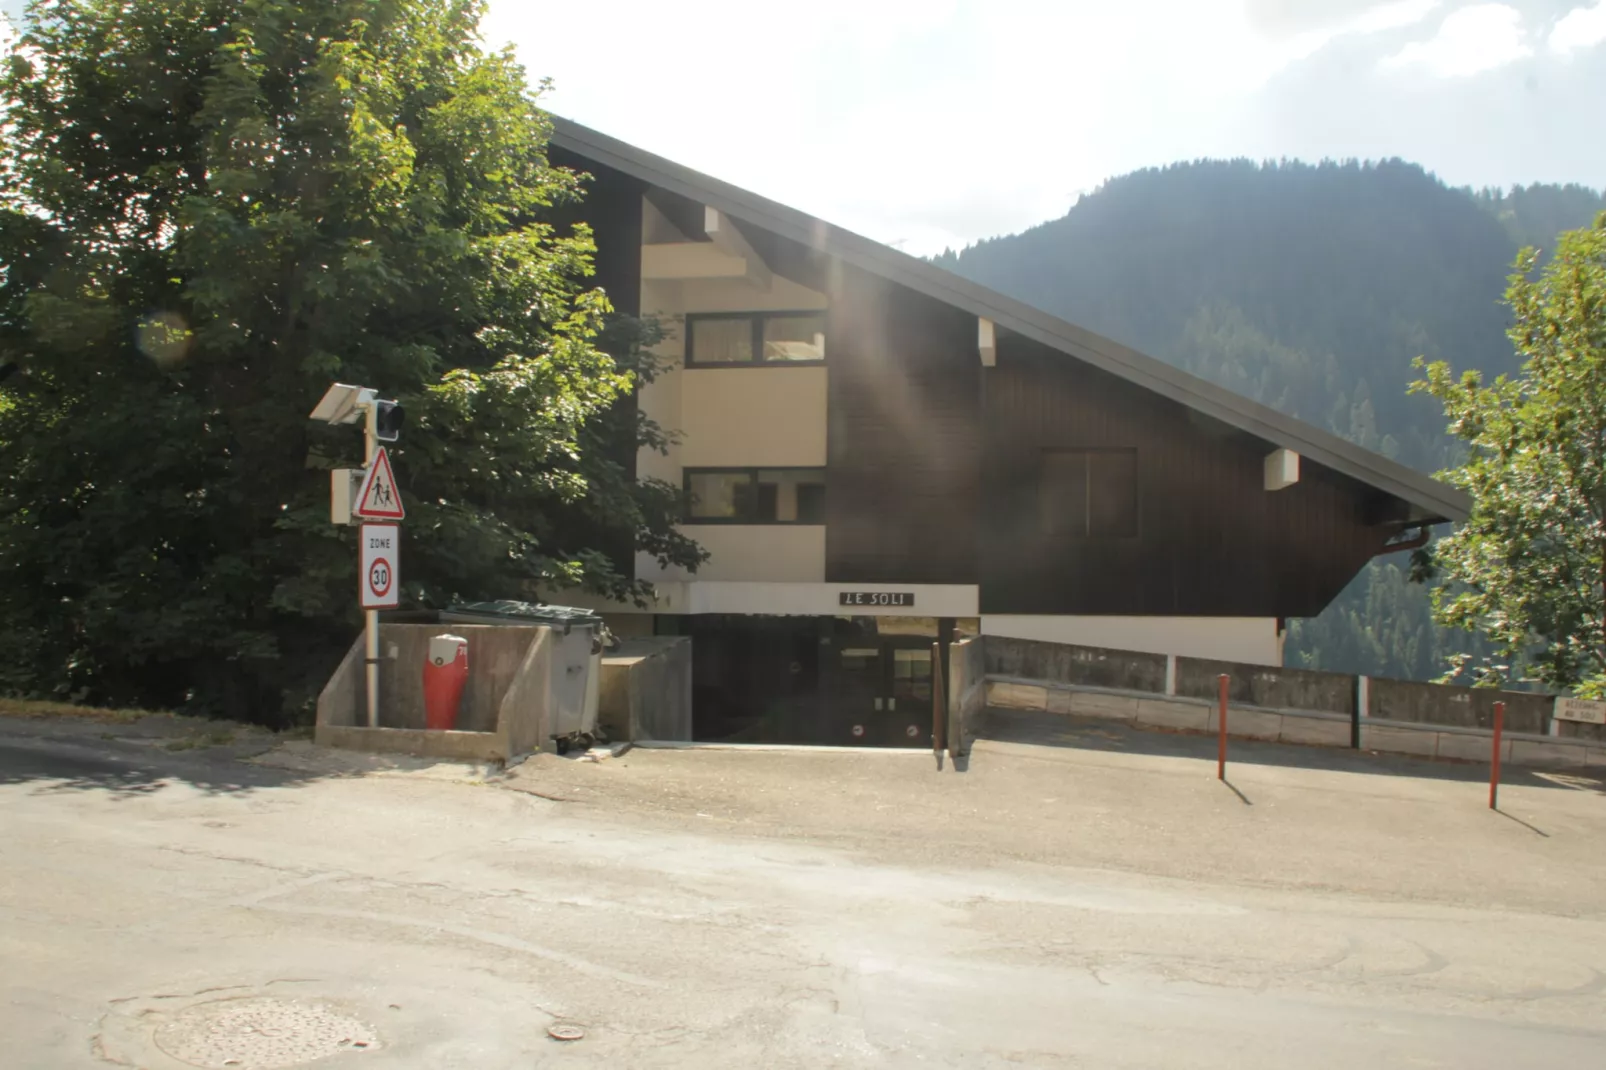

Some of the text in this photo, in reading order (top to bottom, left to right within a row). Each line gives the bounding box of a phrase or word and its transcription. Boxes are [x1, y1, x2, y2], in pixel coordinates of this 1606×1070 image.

[369, 538, 391, 549] ZONE
[373, 569, 387, 585] 30
[845, 593, 904, 605] LE SOLI
